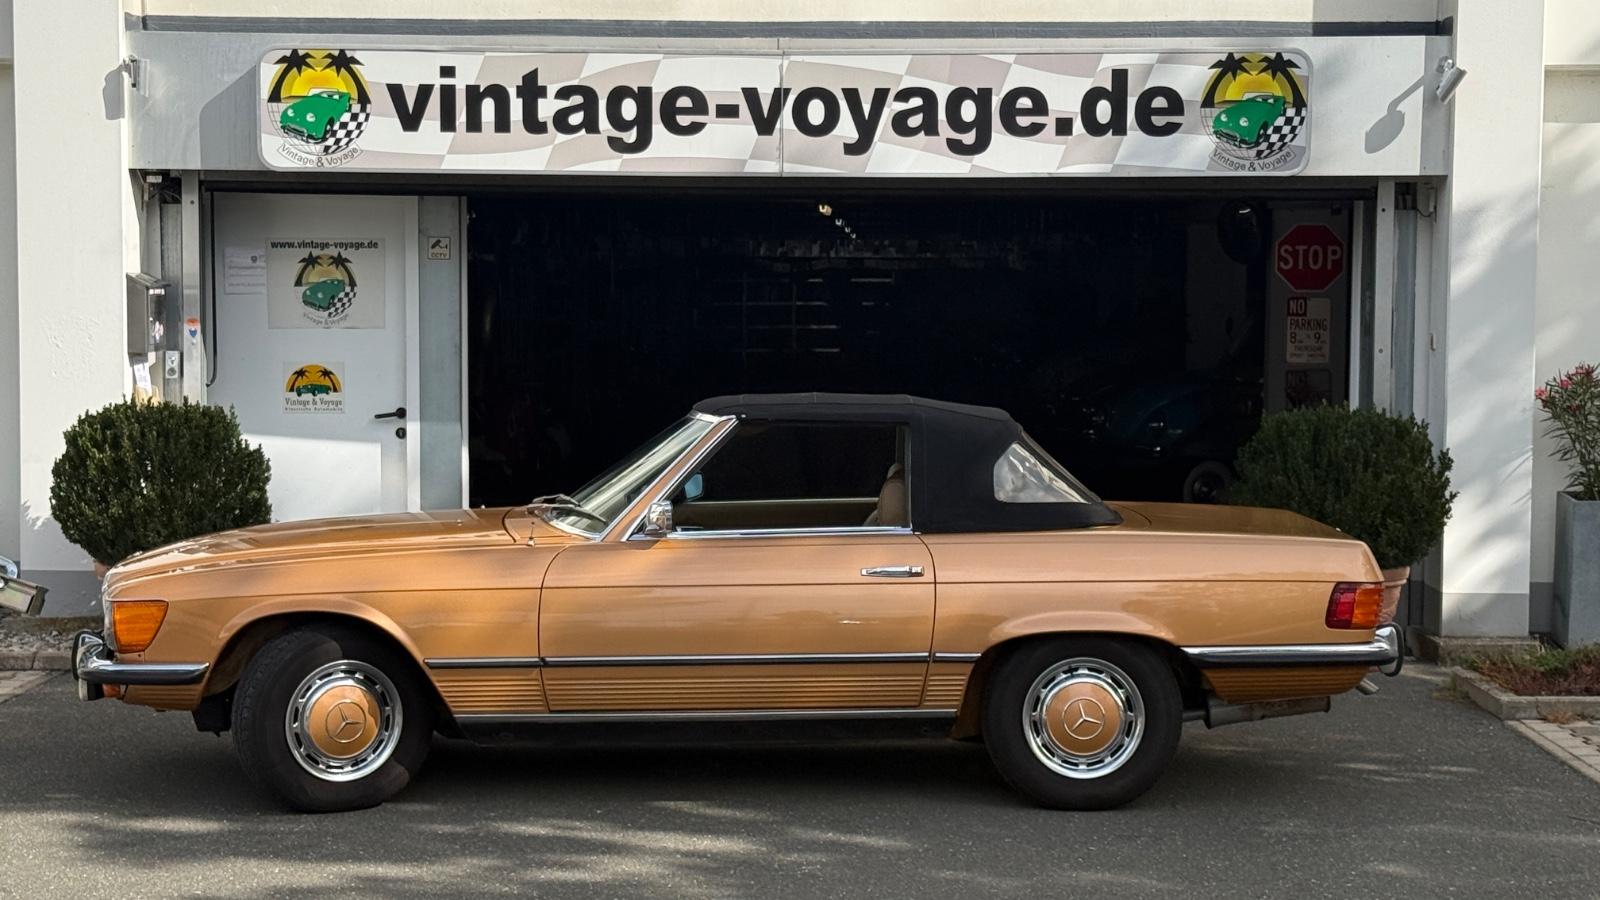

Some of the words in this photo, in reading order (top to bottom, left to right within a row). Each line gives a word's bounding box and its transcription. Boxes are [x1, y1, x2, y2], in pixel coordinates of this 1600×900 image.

[385, 65, 1185, 156] vintage-voyage.de
[281, 143, 315, 166] Vintage
[316, 156, 325, 168] &
[326, 147, 359, 166] Voyage
[1213, 149, 1246, 171] Vintage
[1247, 161, 1256, 172] &
[1258, 151, 1292, 171] Voyage
[270, 240, 379, 251] www.vintage-voyage.de
[1279, 245, 1342, 270] STOP
[1289, 299, 1305, 315] NO
[1289, 318, 1328, 331] PARKING
[285, 397, 310, 407] Vintage
[311, 397, 318, 406] &
[319, 397, 343, 407] Voyage
